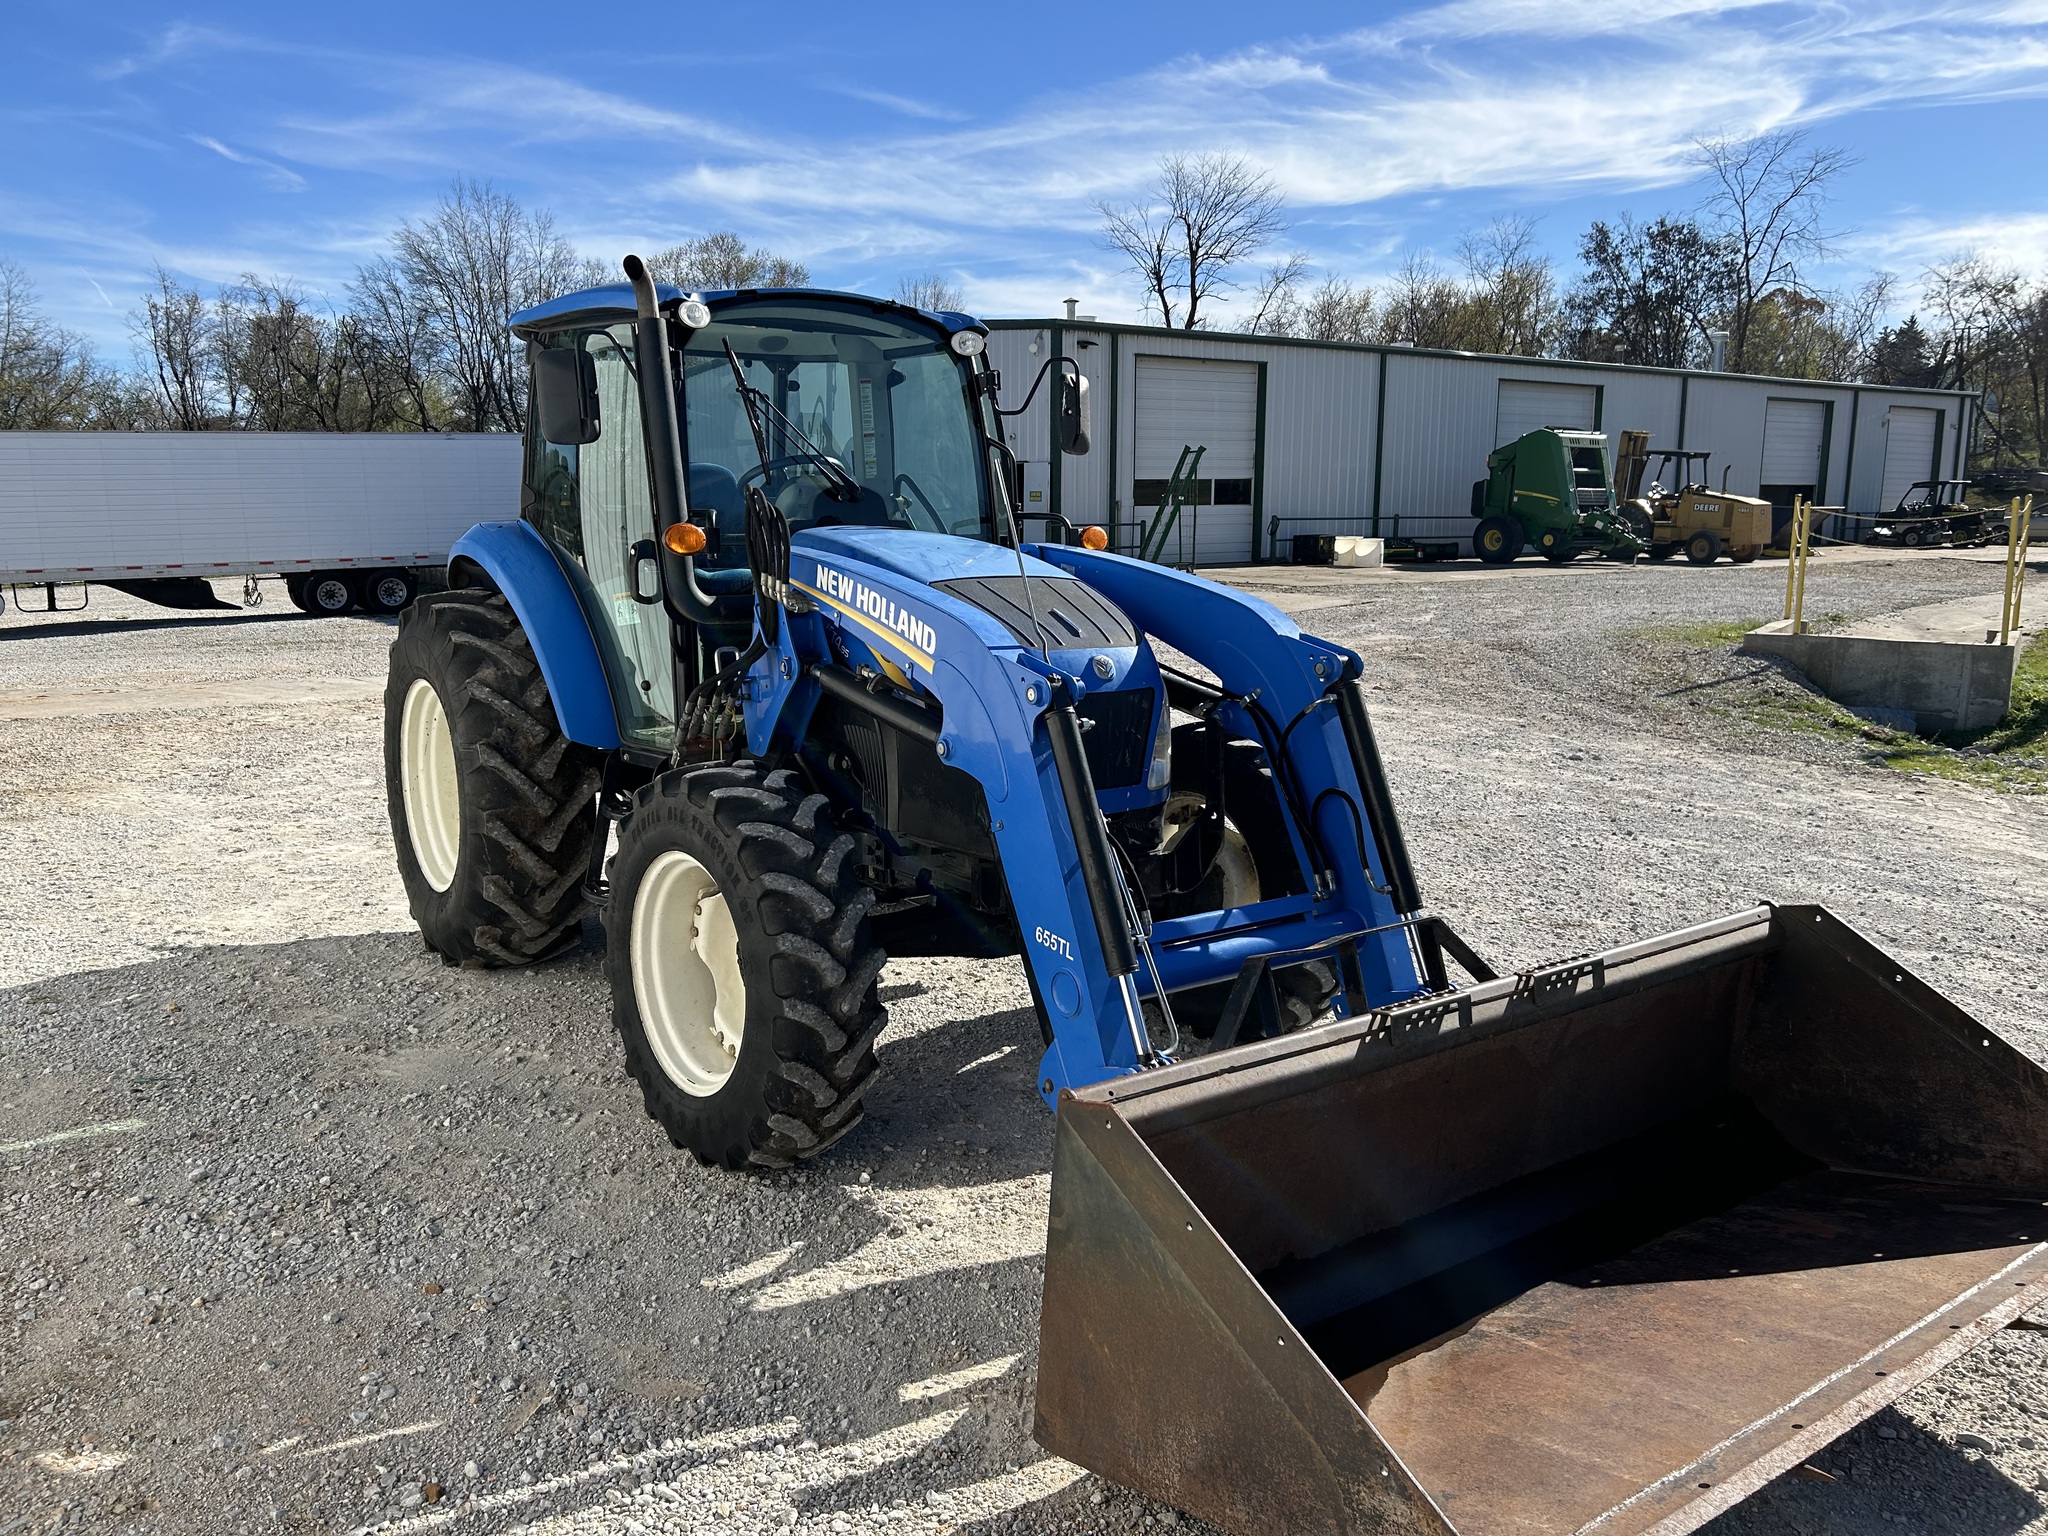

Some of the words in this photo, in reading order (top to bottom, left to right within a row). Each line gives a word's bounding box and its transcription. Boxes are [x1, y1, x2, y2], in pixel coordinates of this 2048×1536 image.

[1694, 503, 1720, 512] DEERE
[816, 563, 855, 604] NEW
[856, 583, 937, 655] HOLLAND
[692, 814, 742, 888] TRACTION
[1035, 926, 1074, 961] 655TL
